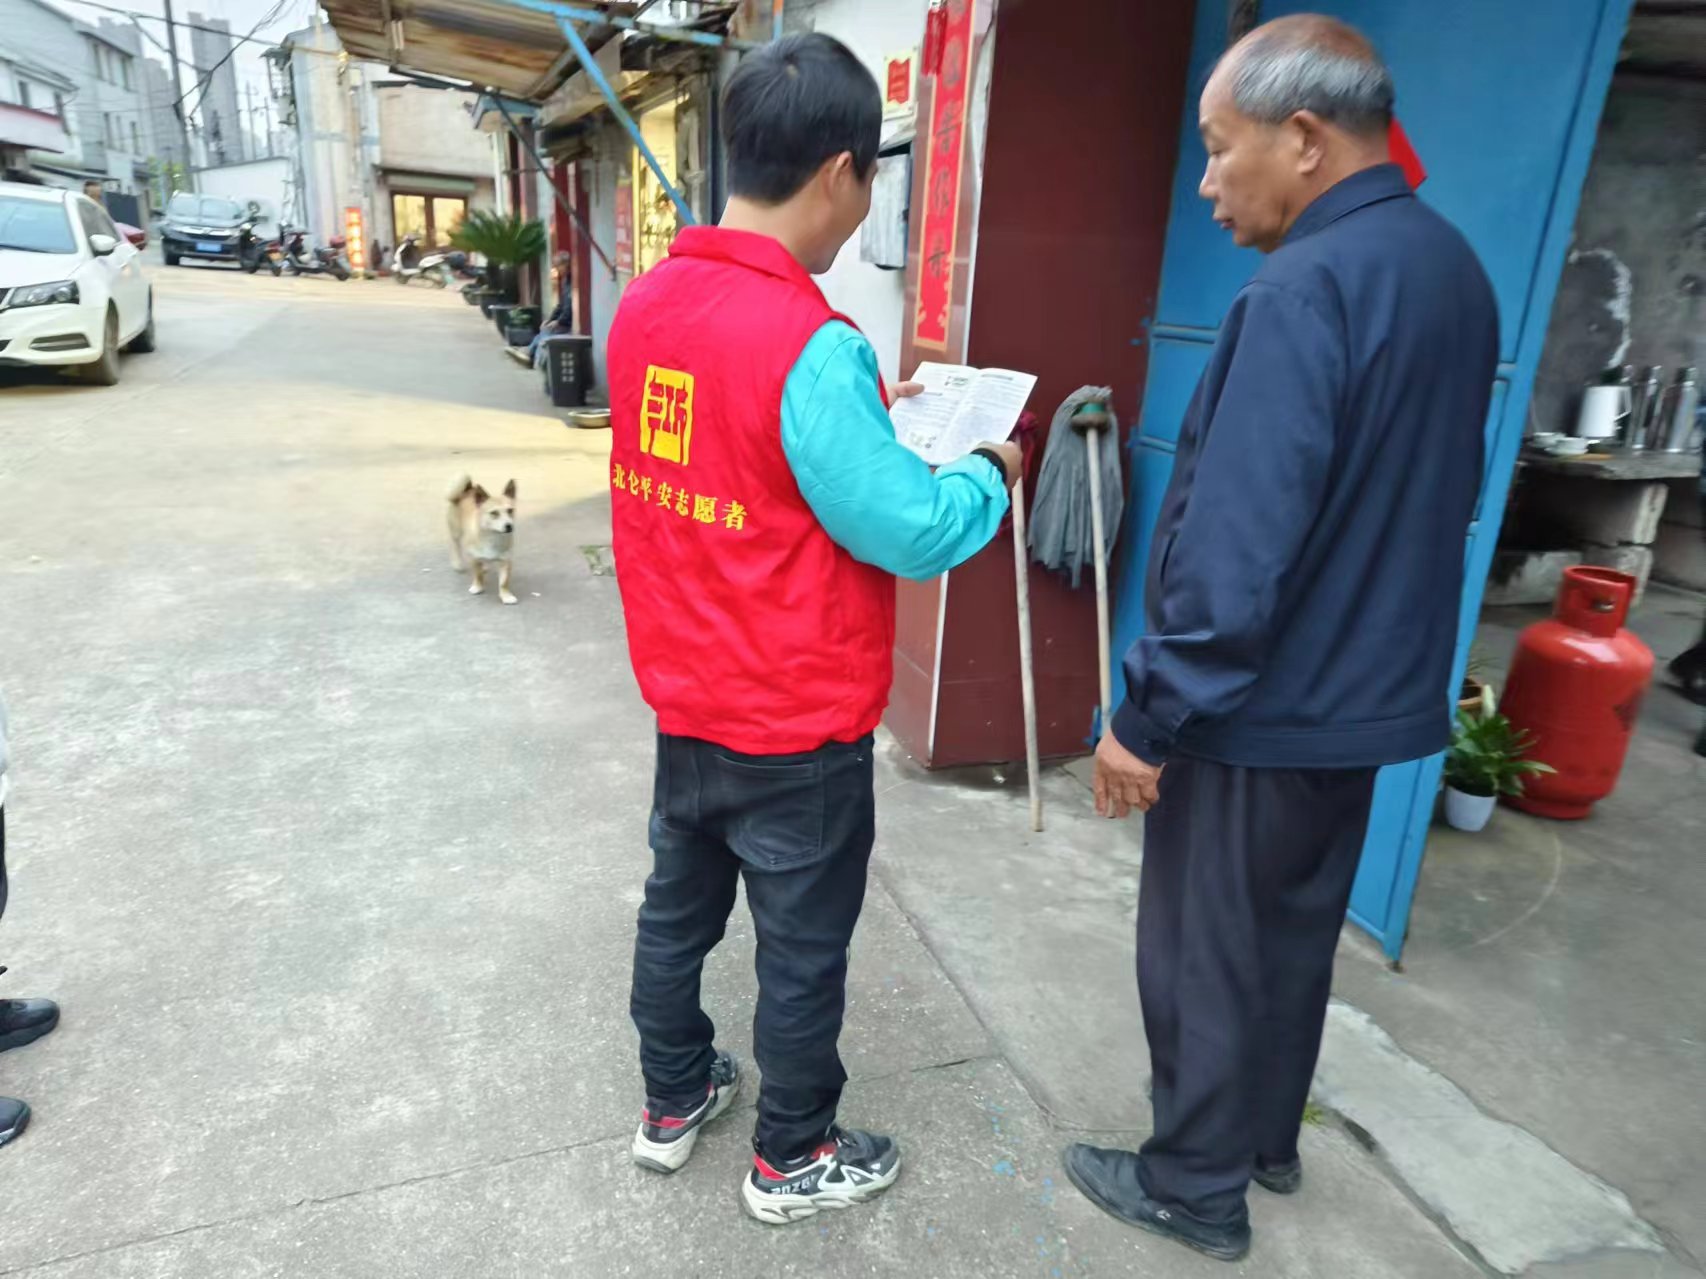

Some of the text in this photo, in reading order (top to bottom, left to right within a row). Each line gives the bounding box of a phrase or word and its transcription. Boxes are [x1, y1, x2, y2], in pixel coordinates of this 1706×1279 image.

[612, 463, 748, 530] 北仑平安志愿者
